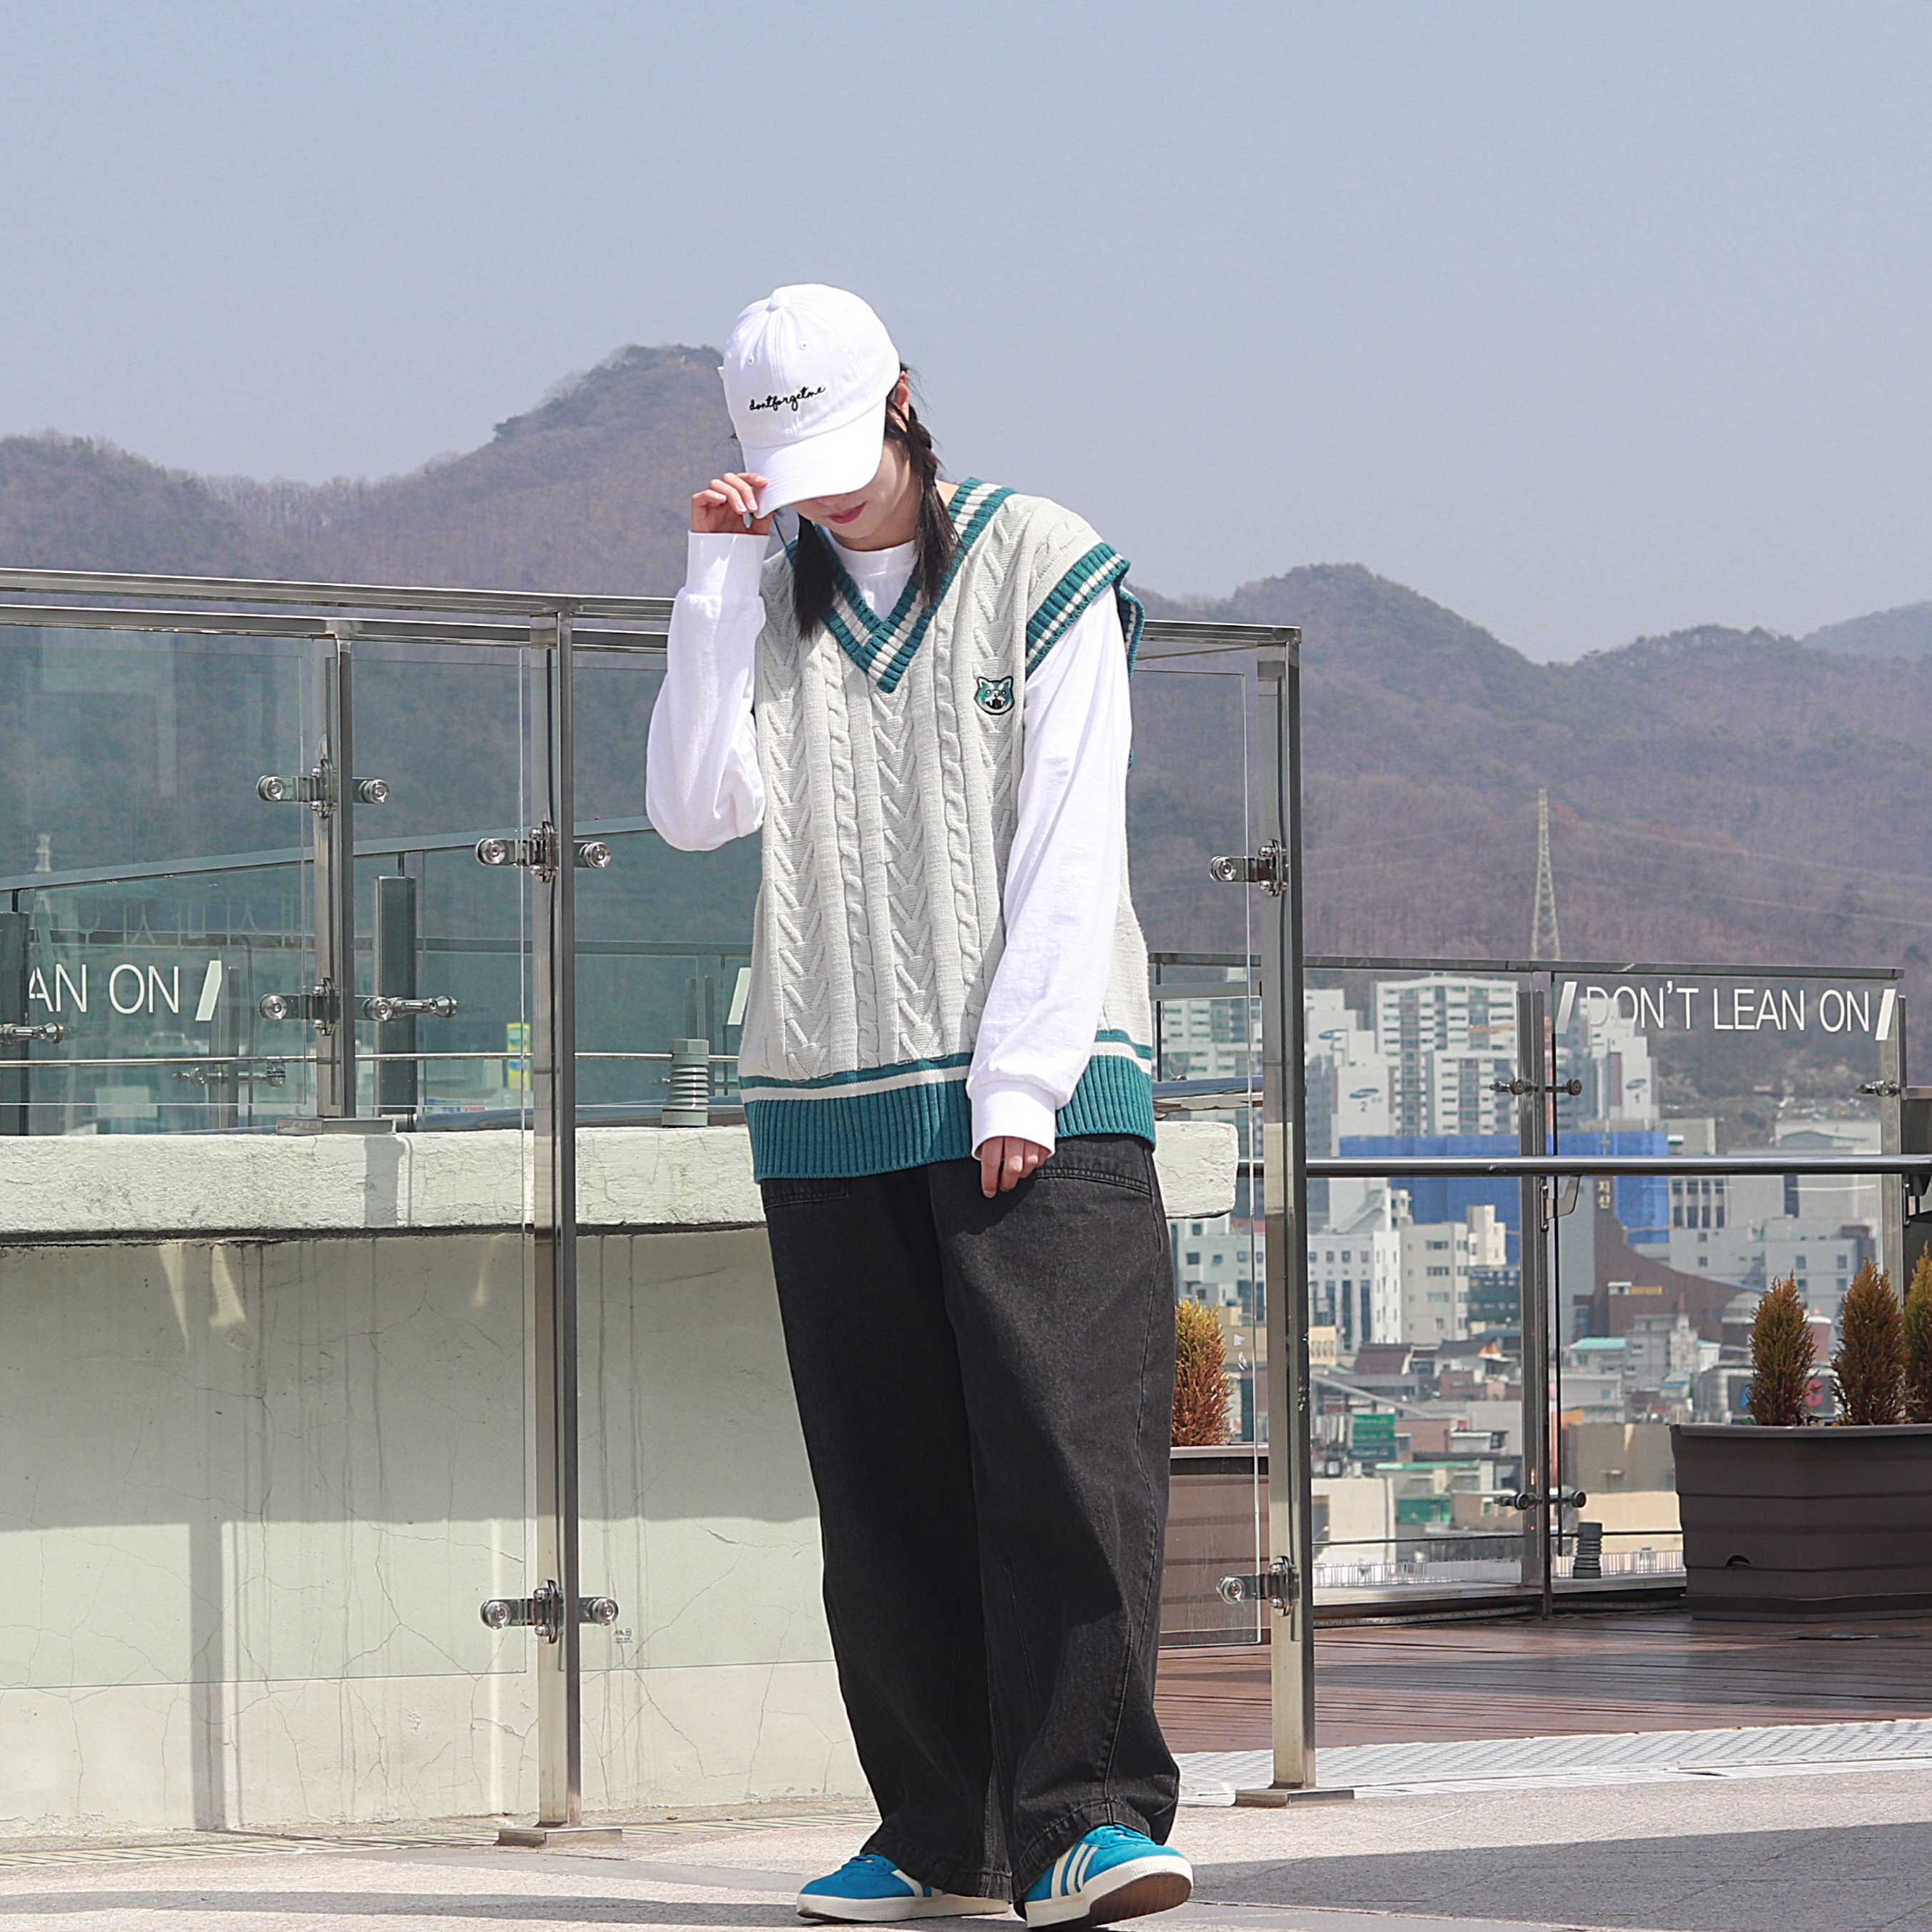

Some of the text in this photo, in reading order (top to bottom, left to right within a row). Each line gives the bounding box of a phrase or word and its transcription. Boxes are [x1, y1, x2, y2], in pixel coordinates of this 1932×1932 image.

[750, 386, 826, 411] dontforgetme
[109, 963, 180, 1014] ON
[1586, 980, 1870, 1033] DON'T LEAN ON
